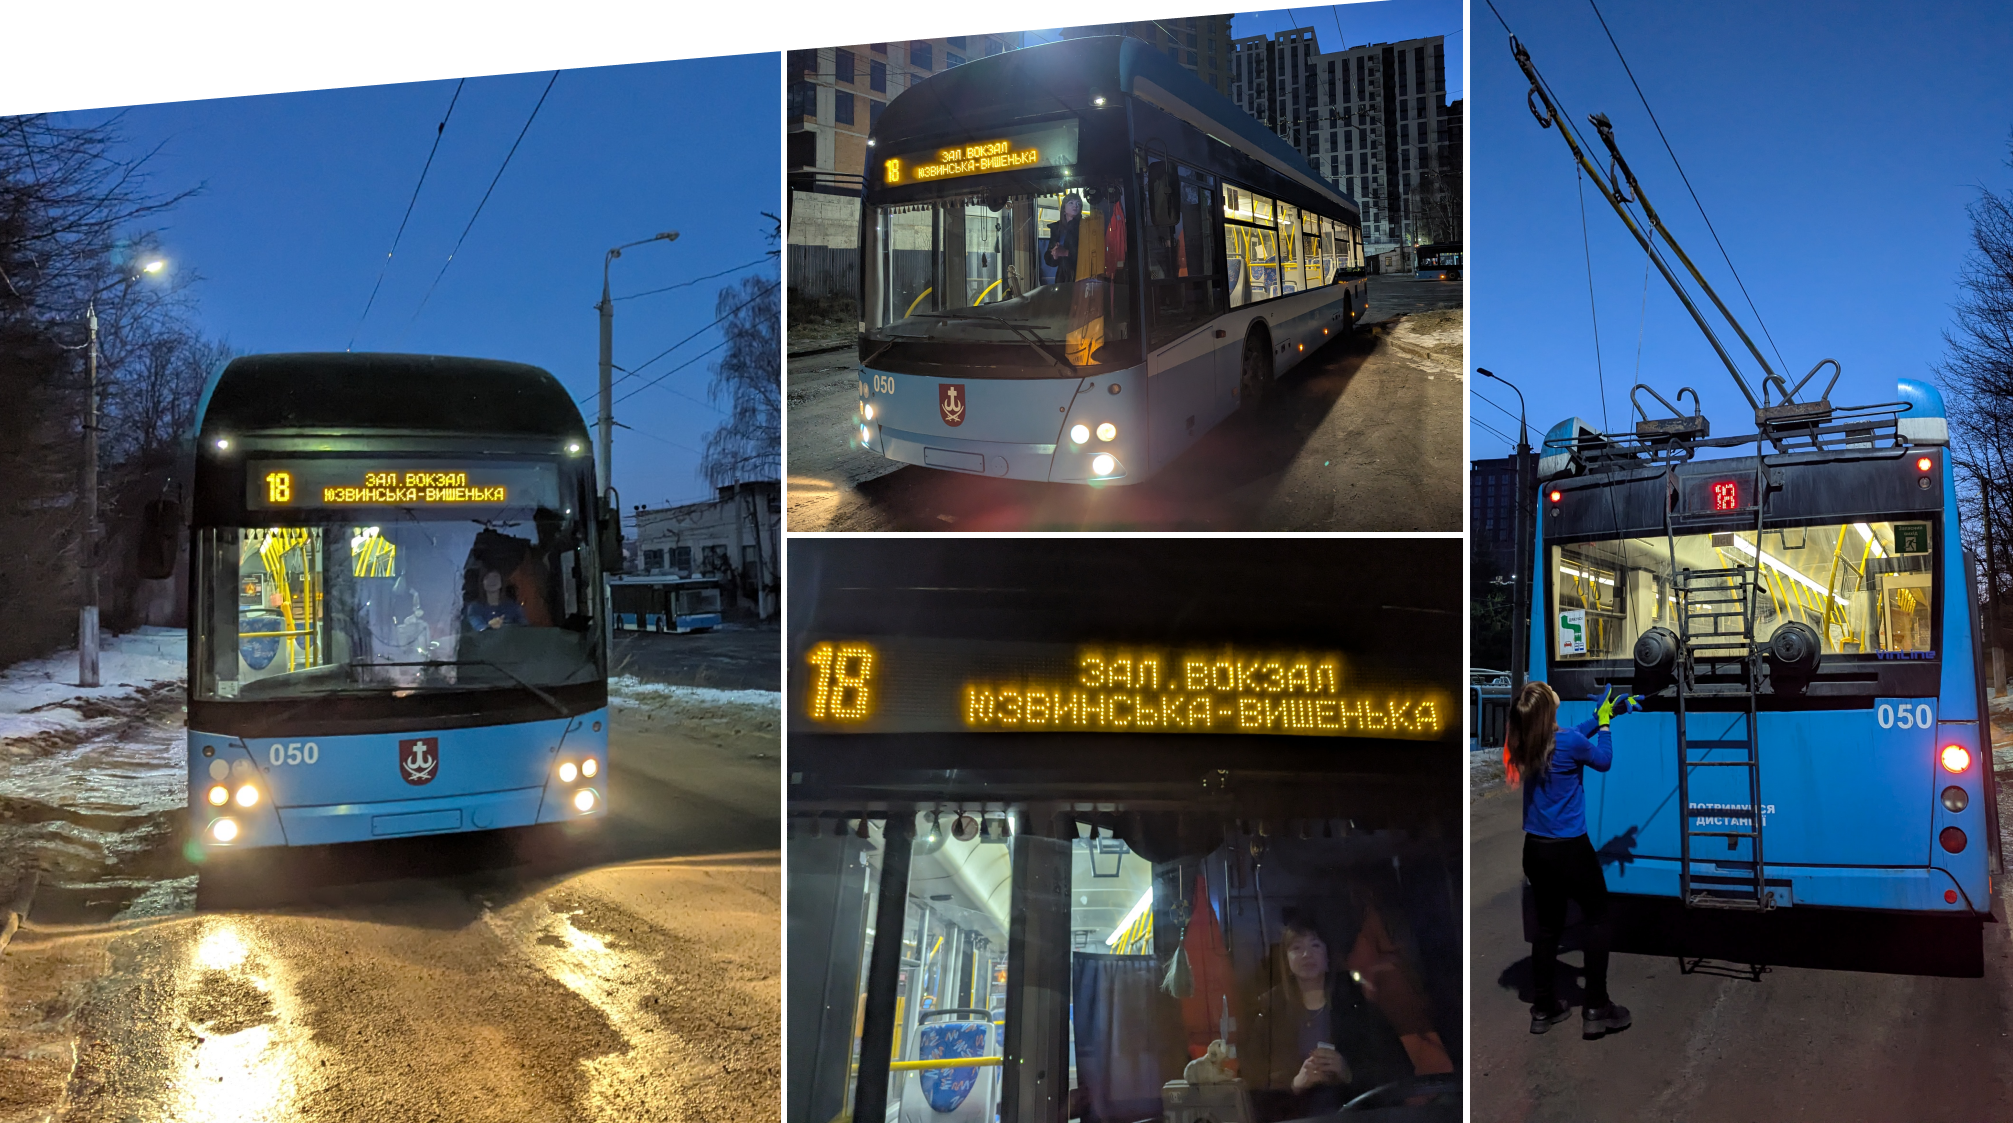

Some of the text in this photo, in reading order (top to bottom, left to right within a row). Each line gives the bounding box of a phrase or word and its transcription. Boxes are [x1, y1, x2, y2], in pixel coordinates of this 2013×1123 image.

[885, 159, 900, 183] 18
[873, 374, 895, 395] 050
[266, 472, 290, 502] 18
[323, 487, 505, 502] ЮЗВИНСЬКА-ВИШЕНЬКА
[811, 646, 872, 718] 18
[968, 690, 1438, 731] ЮЗВИНСЬКА-ВИШЕНЬКА
[1877, 703, 1933, 730] 050
[269, 741, 320, 766] 050
